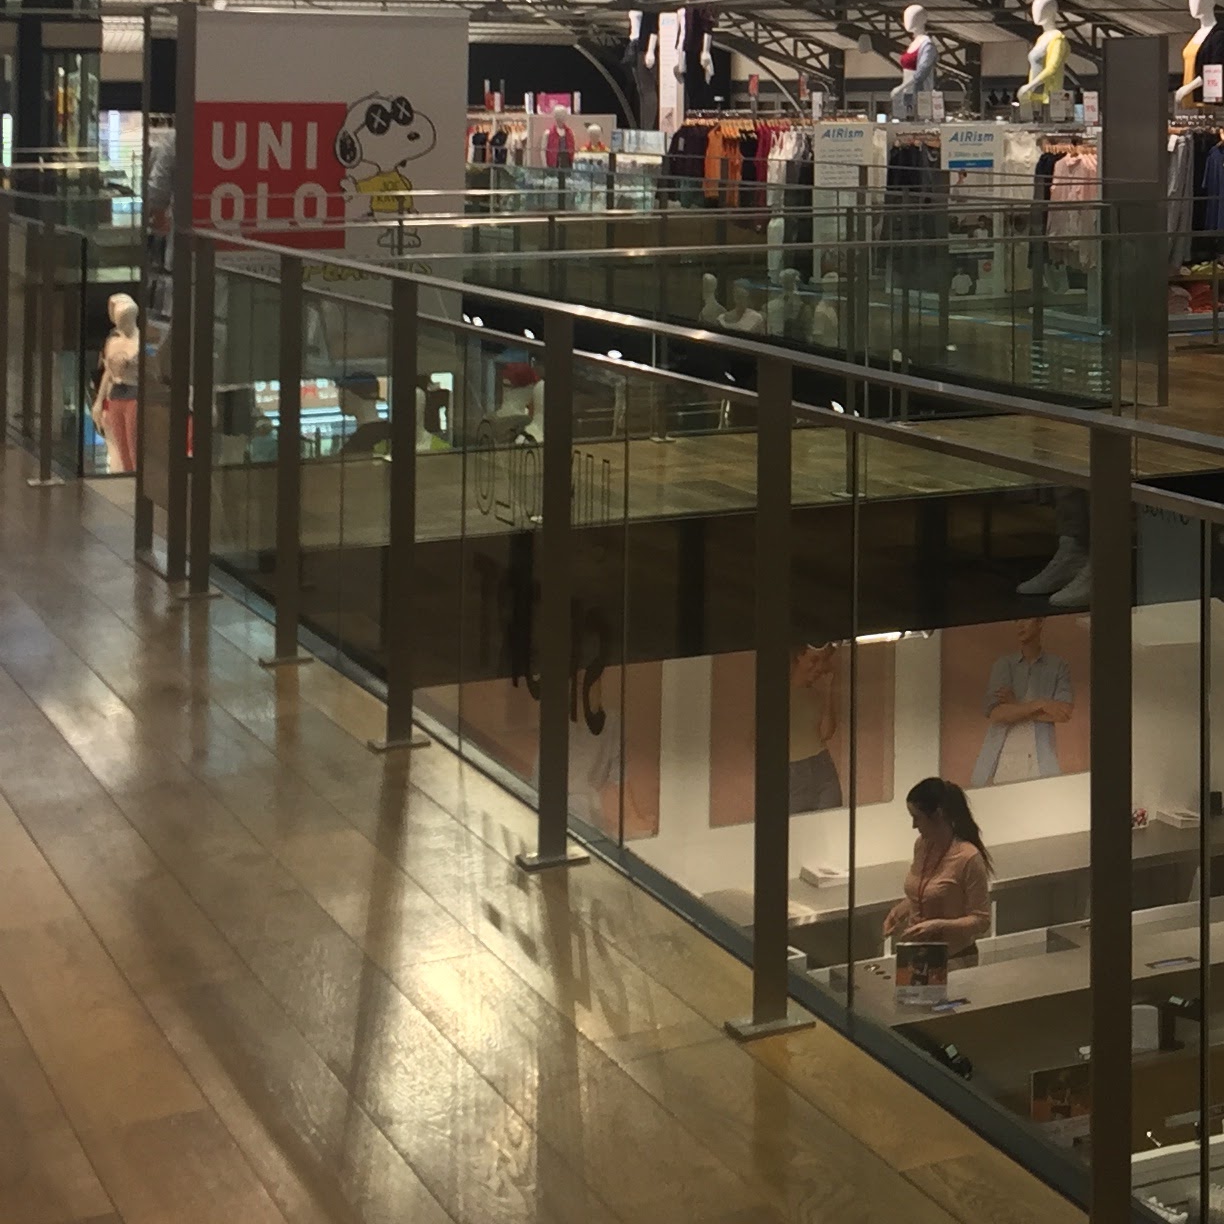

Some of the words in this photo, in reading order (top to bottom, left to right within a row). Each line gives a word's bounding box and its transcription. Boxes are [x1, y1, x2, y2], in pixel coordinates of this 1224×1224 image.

[212, 121, 319, 171] UNI
[822, 127, 864, 138] AIRism
[949, 130, 994, 142] AIRism
[210, 182, 328, 239] QLO
